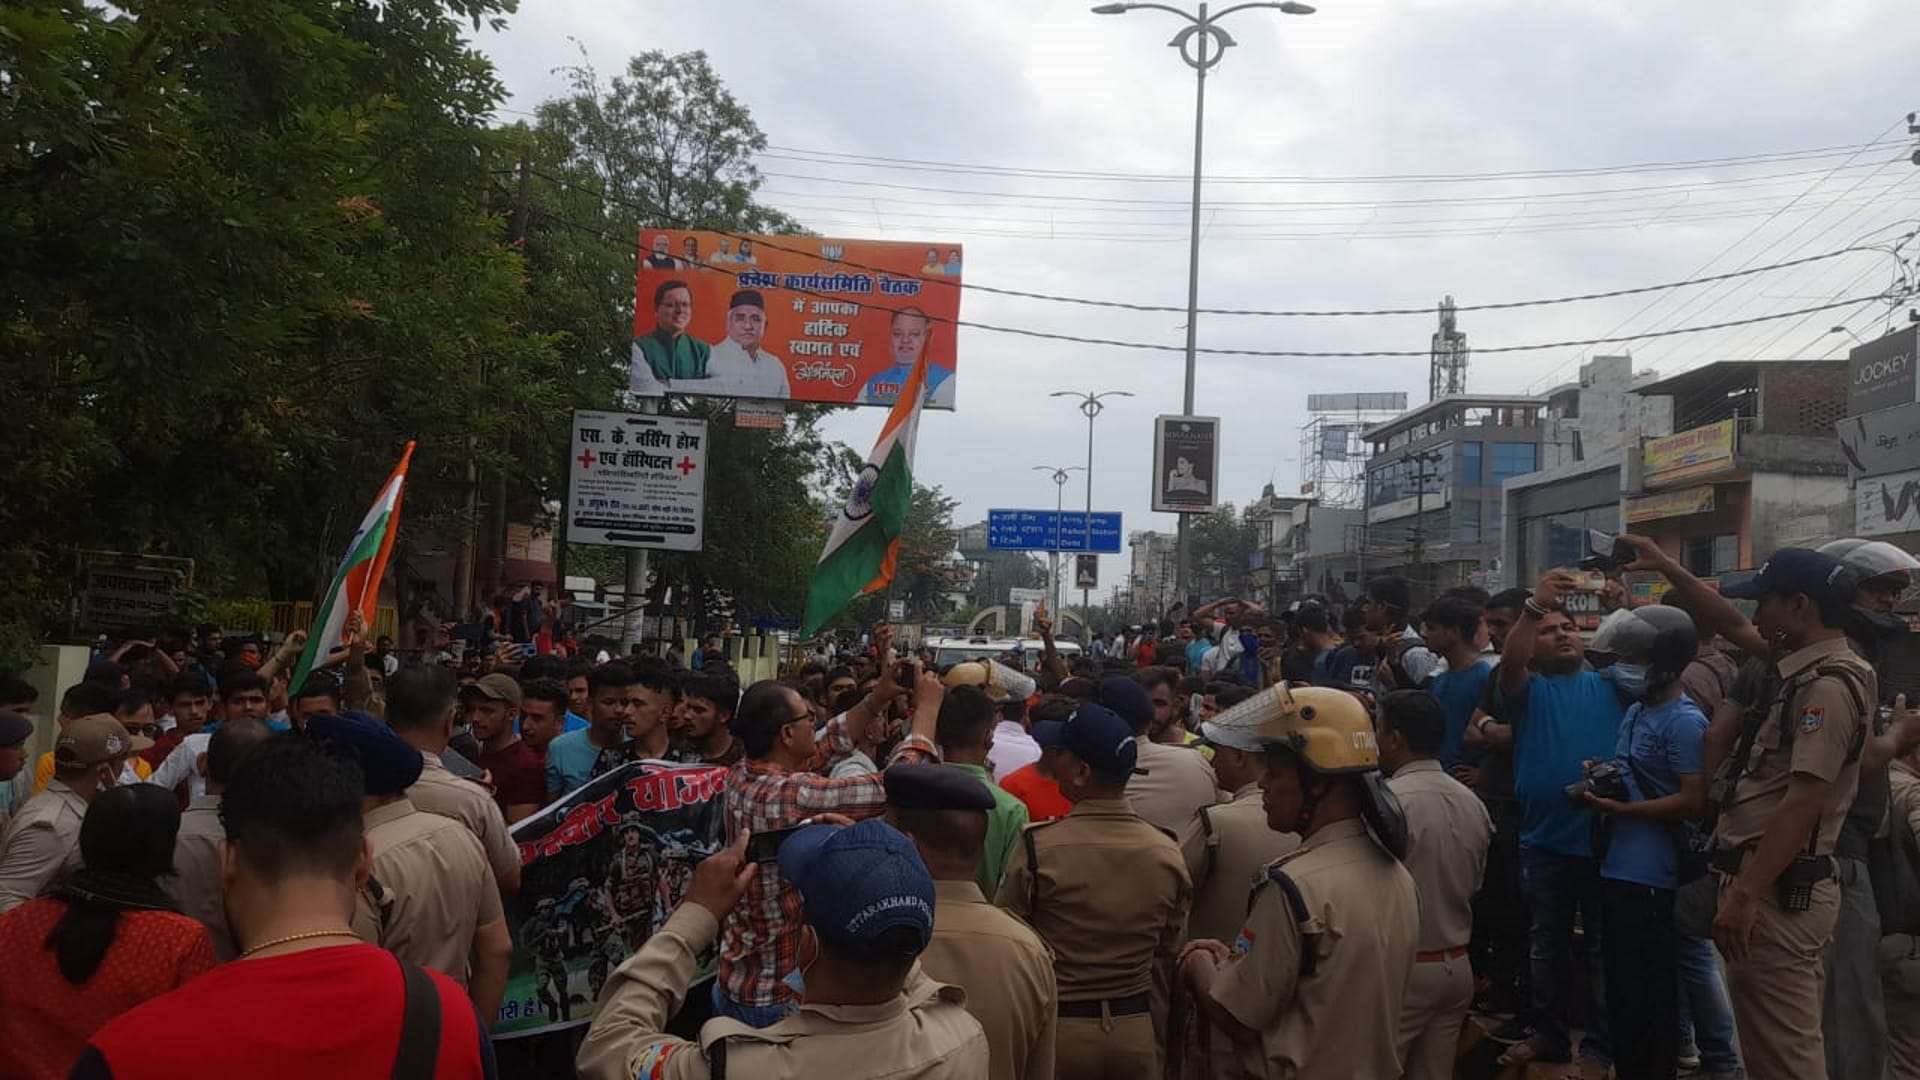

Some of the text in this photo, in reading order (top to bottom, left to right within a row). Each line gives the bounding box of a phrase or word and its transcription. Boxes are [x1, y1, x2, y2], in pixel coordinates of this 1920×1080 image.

[784, 272, 873, 294] कार्यसमिति
[880, 274, 920, 295] बैठक
[792, 298, 859, 315] में आपका
[803, 319, 849, 338] हार्दिक
[789, 341, 864, 357] स्वागत एवं
[1854, 351, 1911, 385] JOCKEY
[580, 426, 700, 450] एस. के. नर्सिंग होम
[599, 448, 673, 470] एवं हॉस्पिटल
[846, 895, 918, 933] UTTARAKHAND
